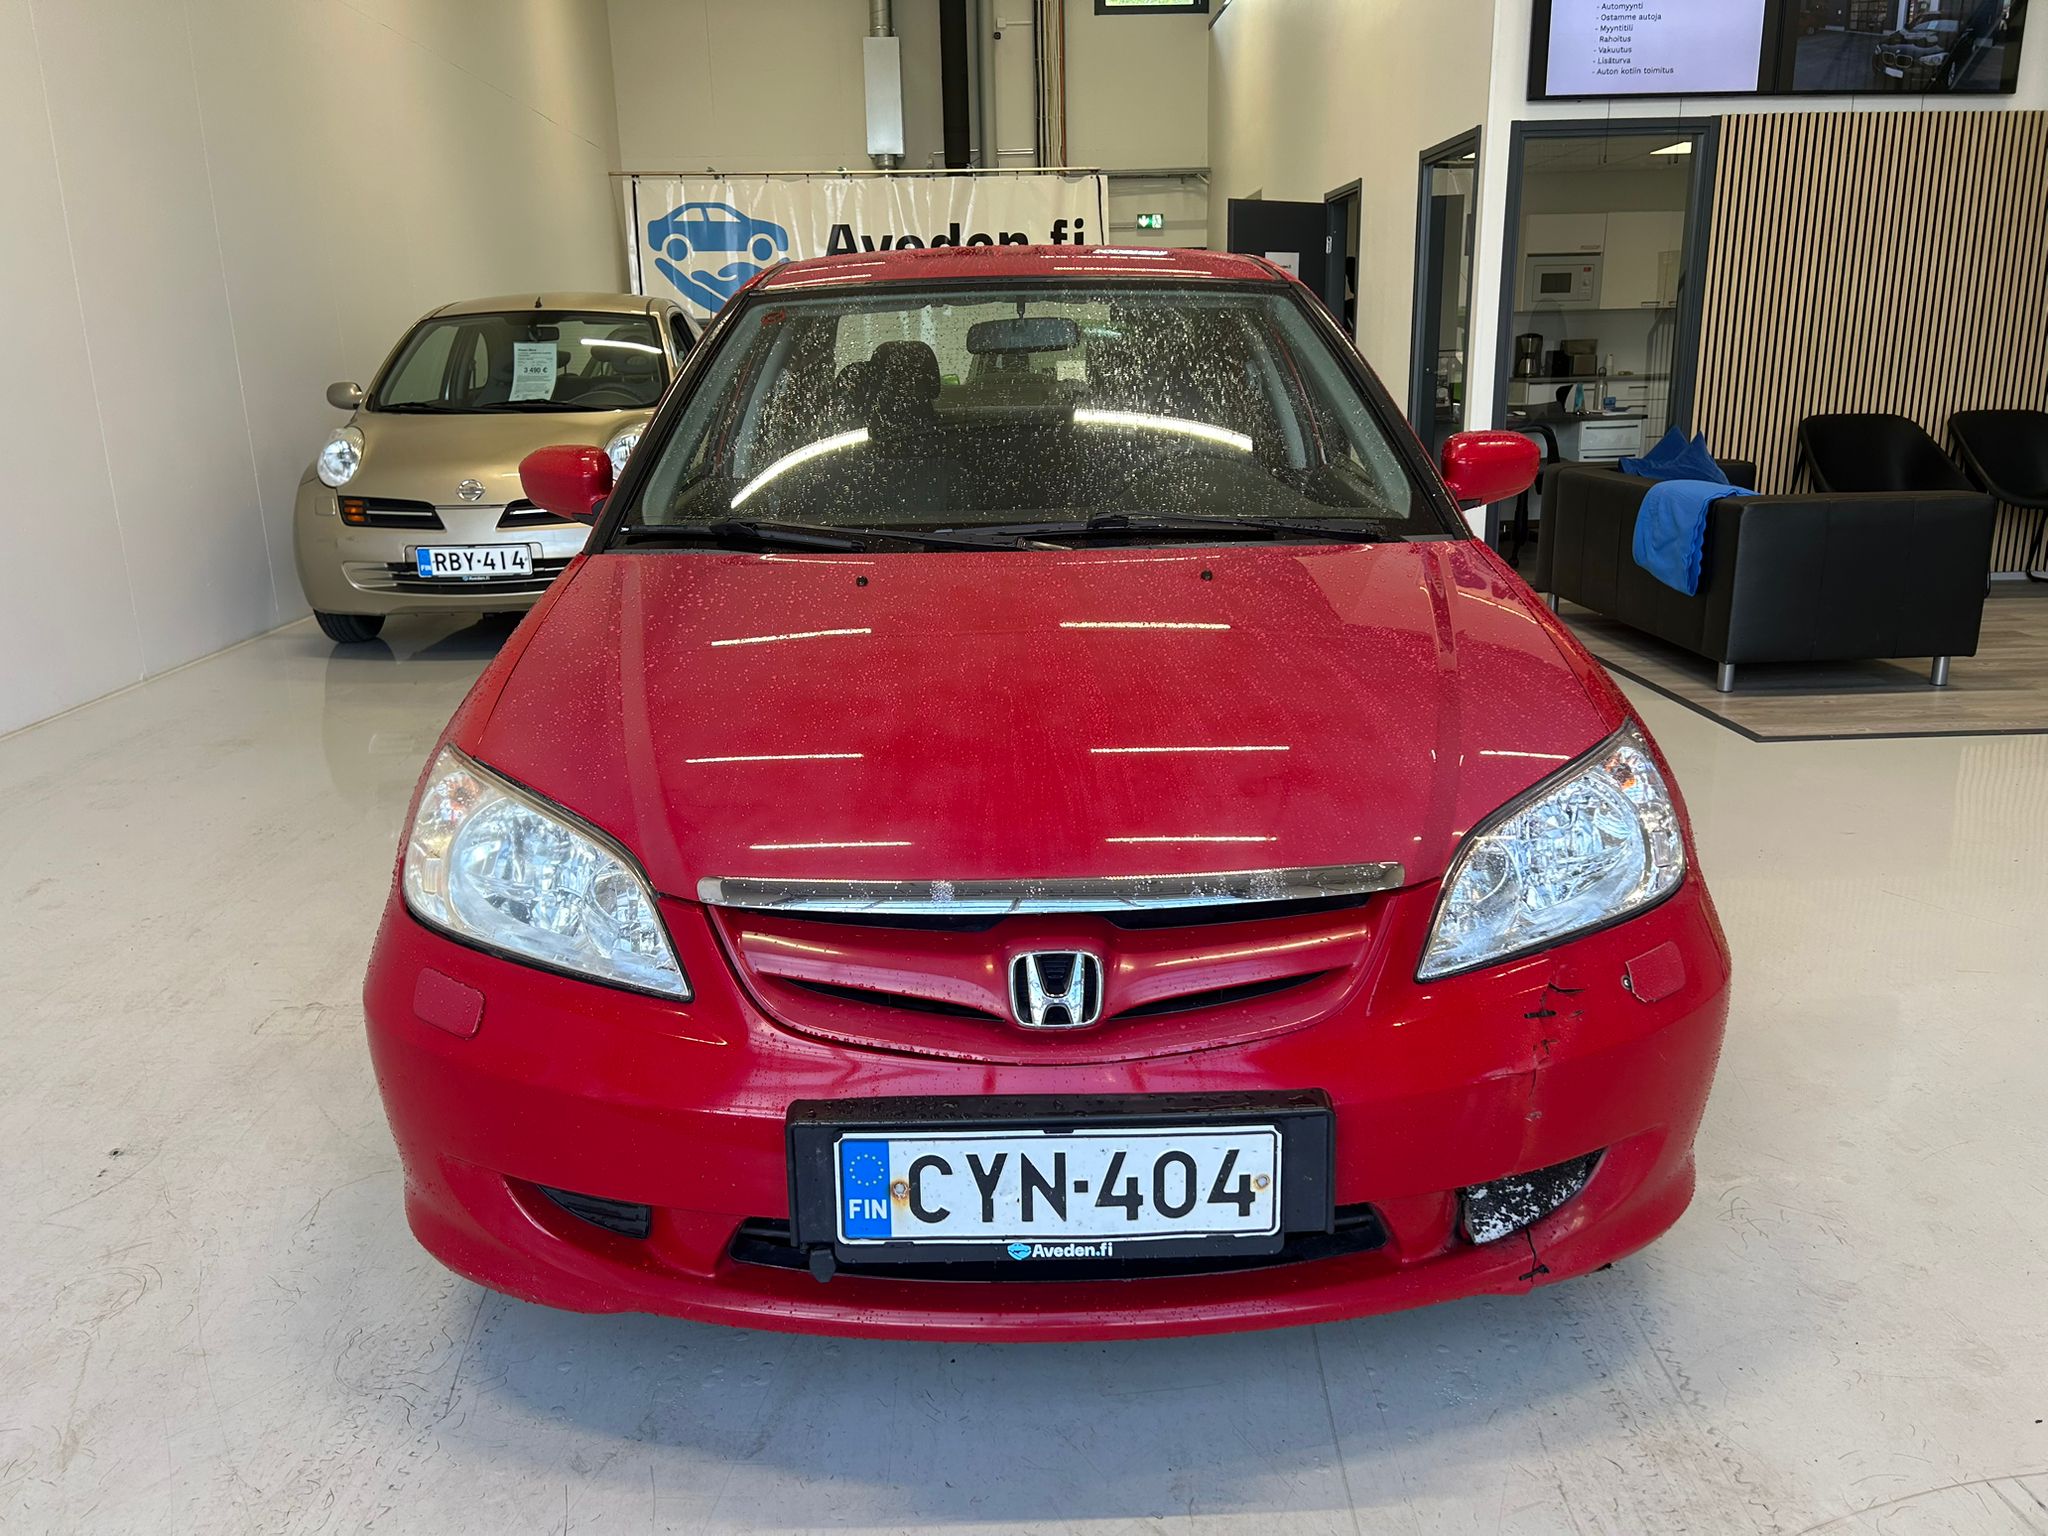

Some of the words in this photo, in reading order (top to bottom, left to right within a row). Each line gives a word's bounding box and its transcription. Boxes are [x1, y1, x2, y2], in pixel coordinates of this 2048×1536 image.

[1601, 2, 1644, 11] Automyynti
[1600, 13, 1637, 21] Ostamme
[1638, 12, 1662, 22] autoja
[1599, 24, 1634, 33] Myyntitili
[1599, 35, 1632, 43] Rahoitus
[1598, 46, 1633, 54] Vakuutus
[1597, 57, 1631, 65] Lisäturva
[1620, 66, 1642, 75] kotiin
[1643, 66, 1674, 74] toimitus
[825, 218, 1085, 257] Avdfi
[434, 550, 526, 572] RBY-414
[907, 1148, 1257, 1224] CYN-404
[848, 1198, 888, 1220] FIN
[1031, 1242, 1113, 1258] Aveden.fi
